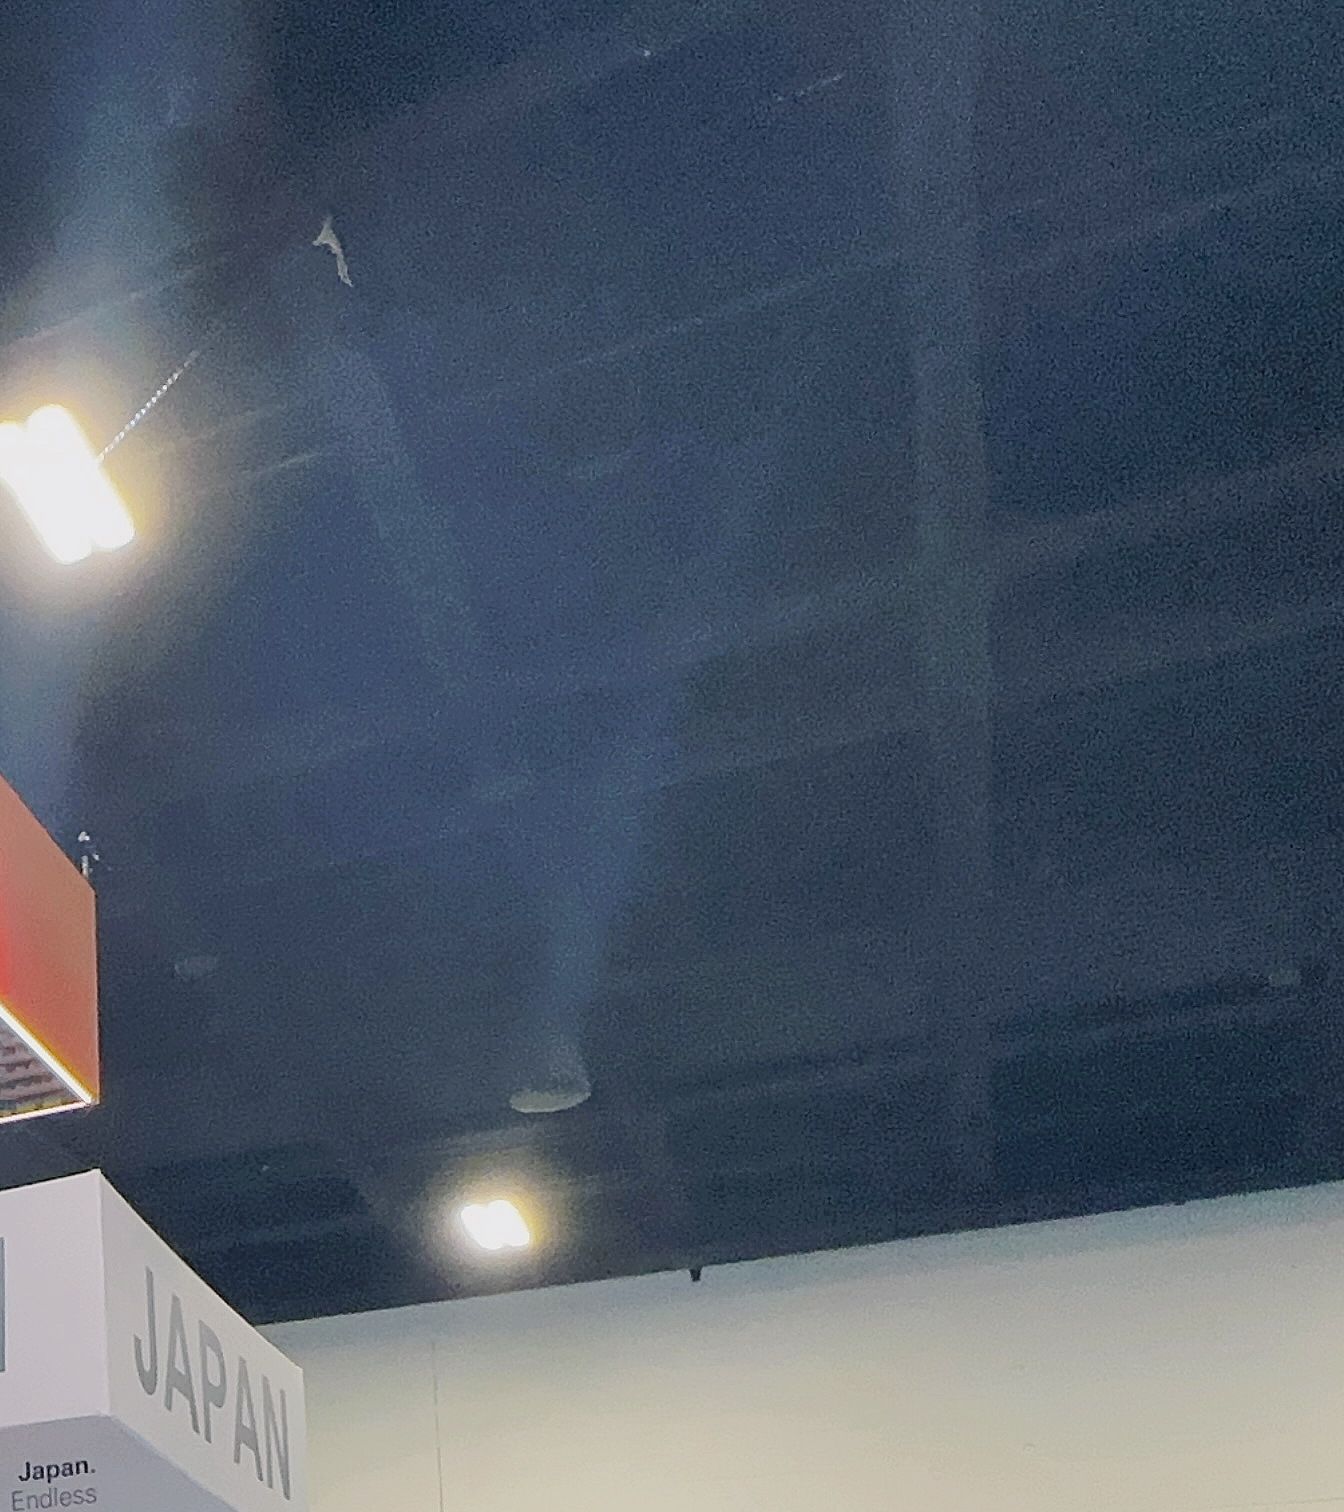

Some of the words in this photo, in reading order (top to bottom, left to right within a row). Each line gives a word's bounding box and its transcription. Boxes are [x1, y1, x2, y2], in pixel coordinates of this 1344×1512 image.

[132, 1266, 294, 1502] JAPAN
[18, 1460, 96, 1484] Japan.
[11, 1487, 97, 1512] Endless
